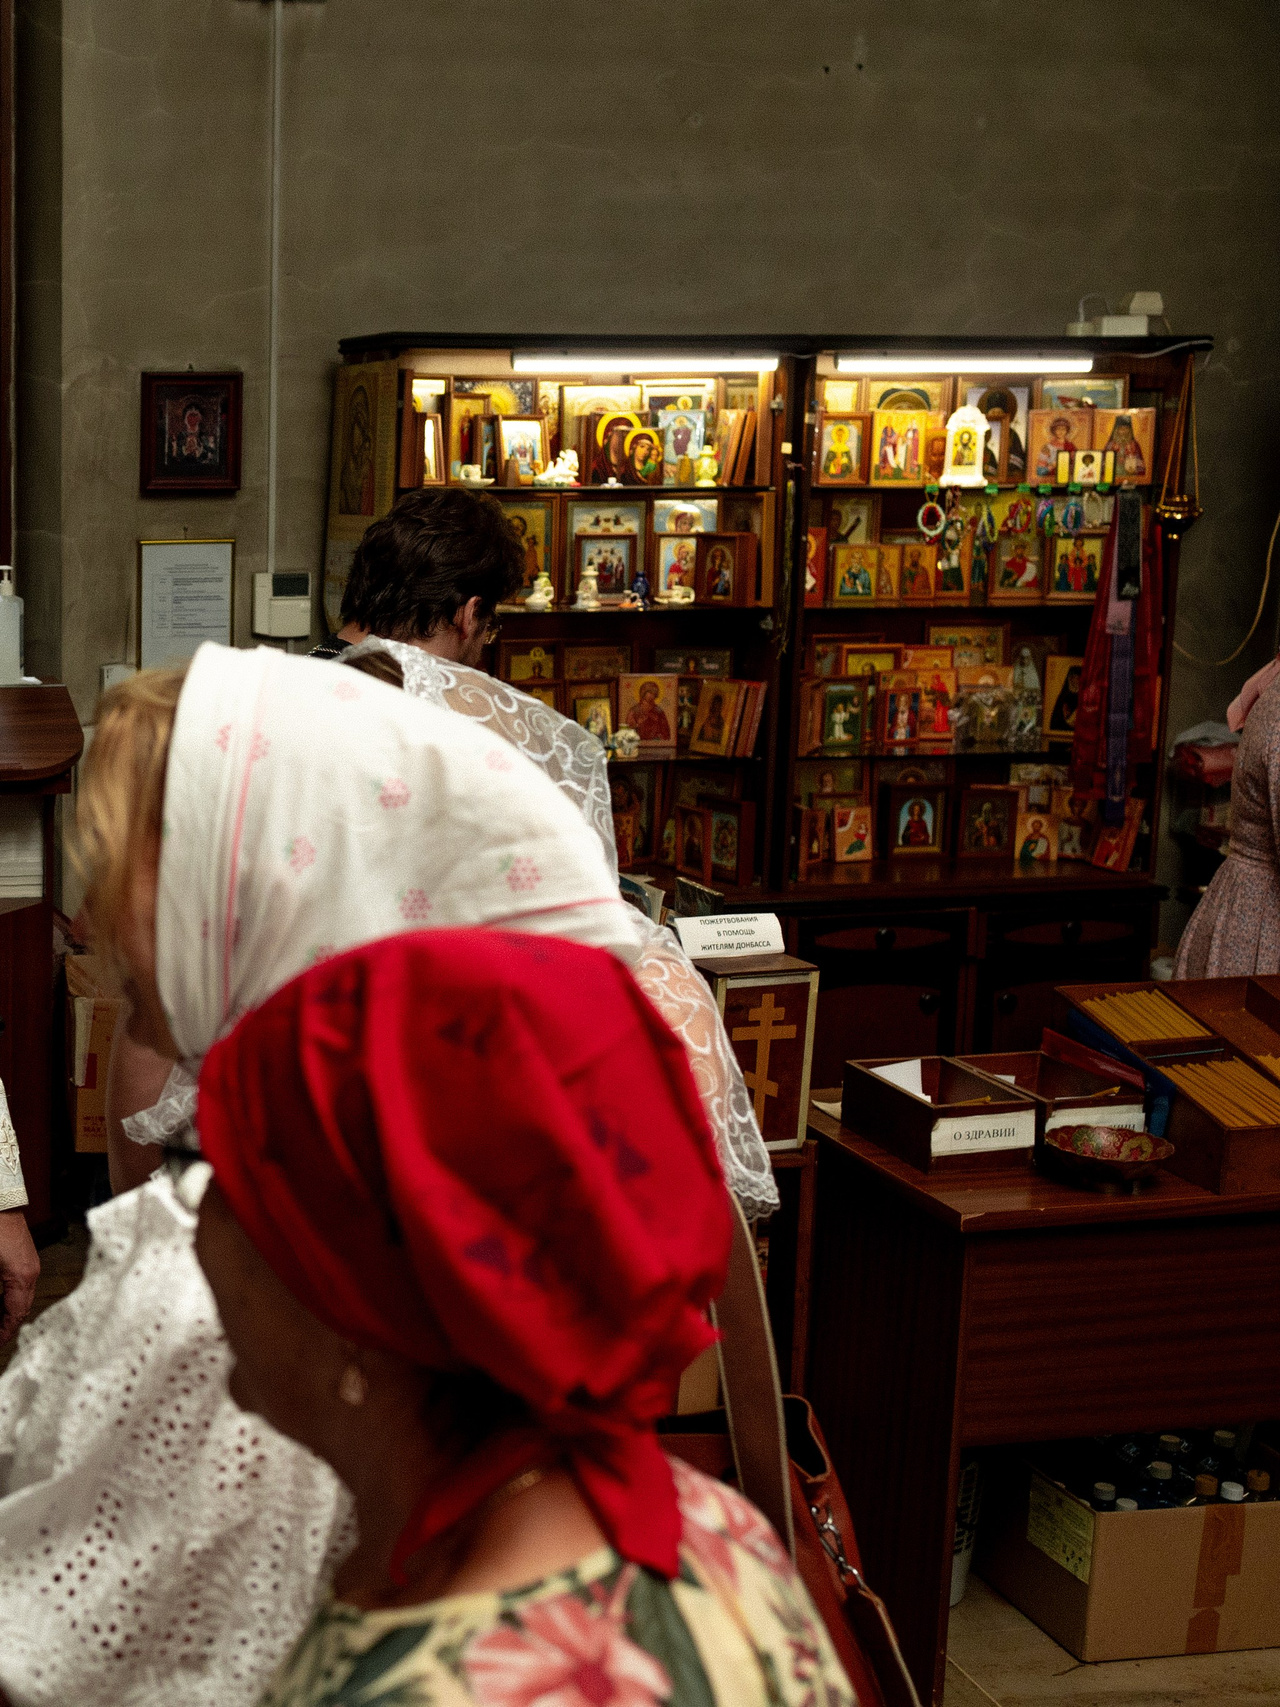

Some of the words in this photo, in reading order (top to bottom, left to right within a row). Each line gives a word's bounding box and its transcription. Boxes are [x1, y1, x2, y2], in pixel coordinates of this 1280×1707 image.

[699, 916, 759, 926] ПОЖЕРТВОВАНИЯ
[722, 928, 756, 937] ПОМОЩЬ
[700, 943, 735, 951] ЖИТЕЛЯМ
[735, 940, 771, 950] ДОНБАССА
[953, 1131, 962, 1141] О
[964, 1127, 1016, 1141] ЗДРАВИИ
